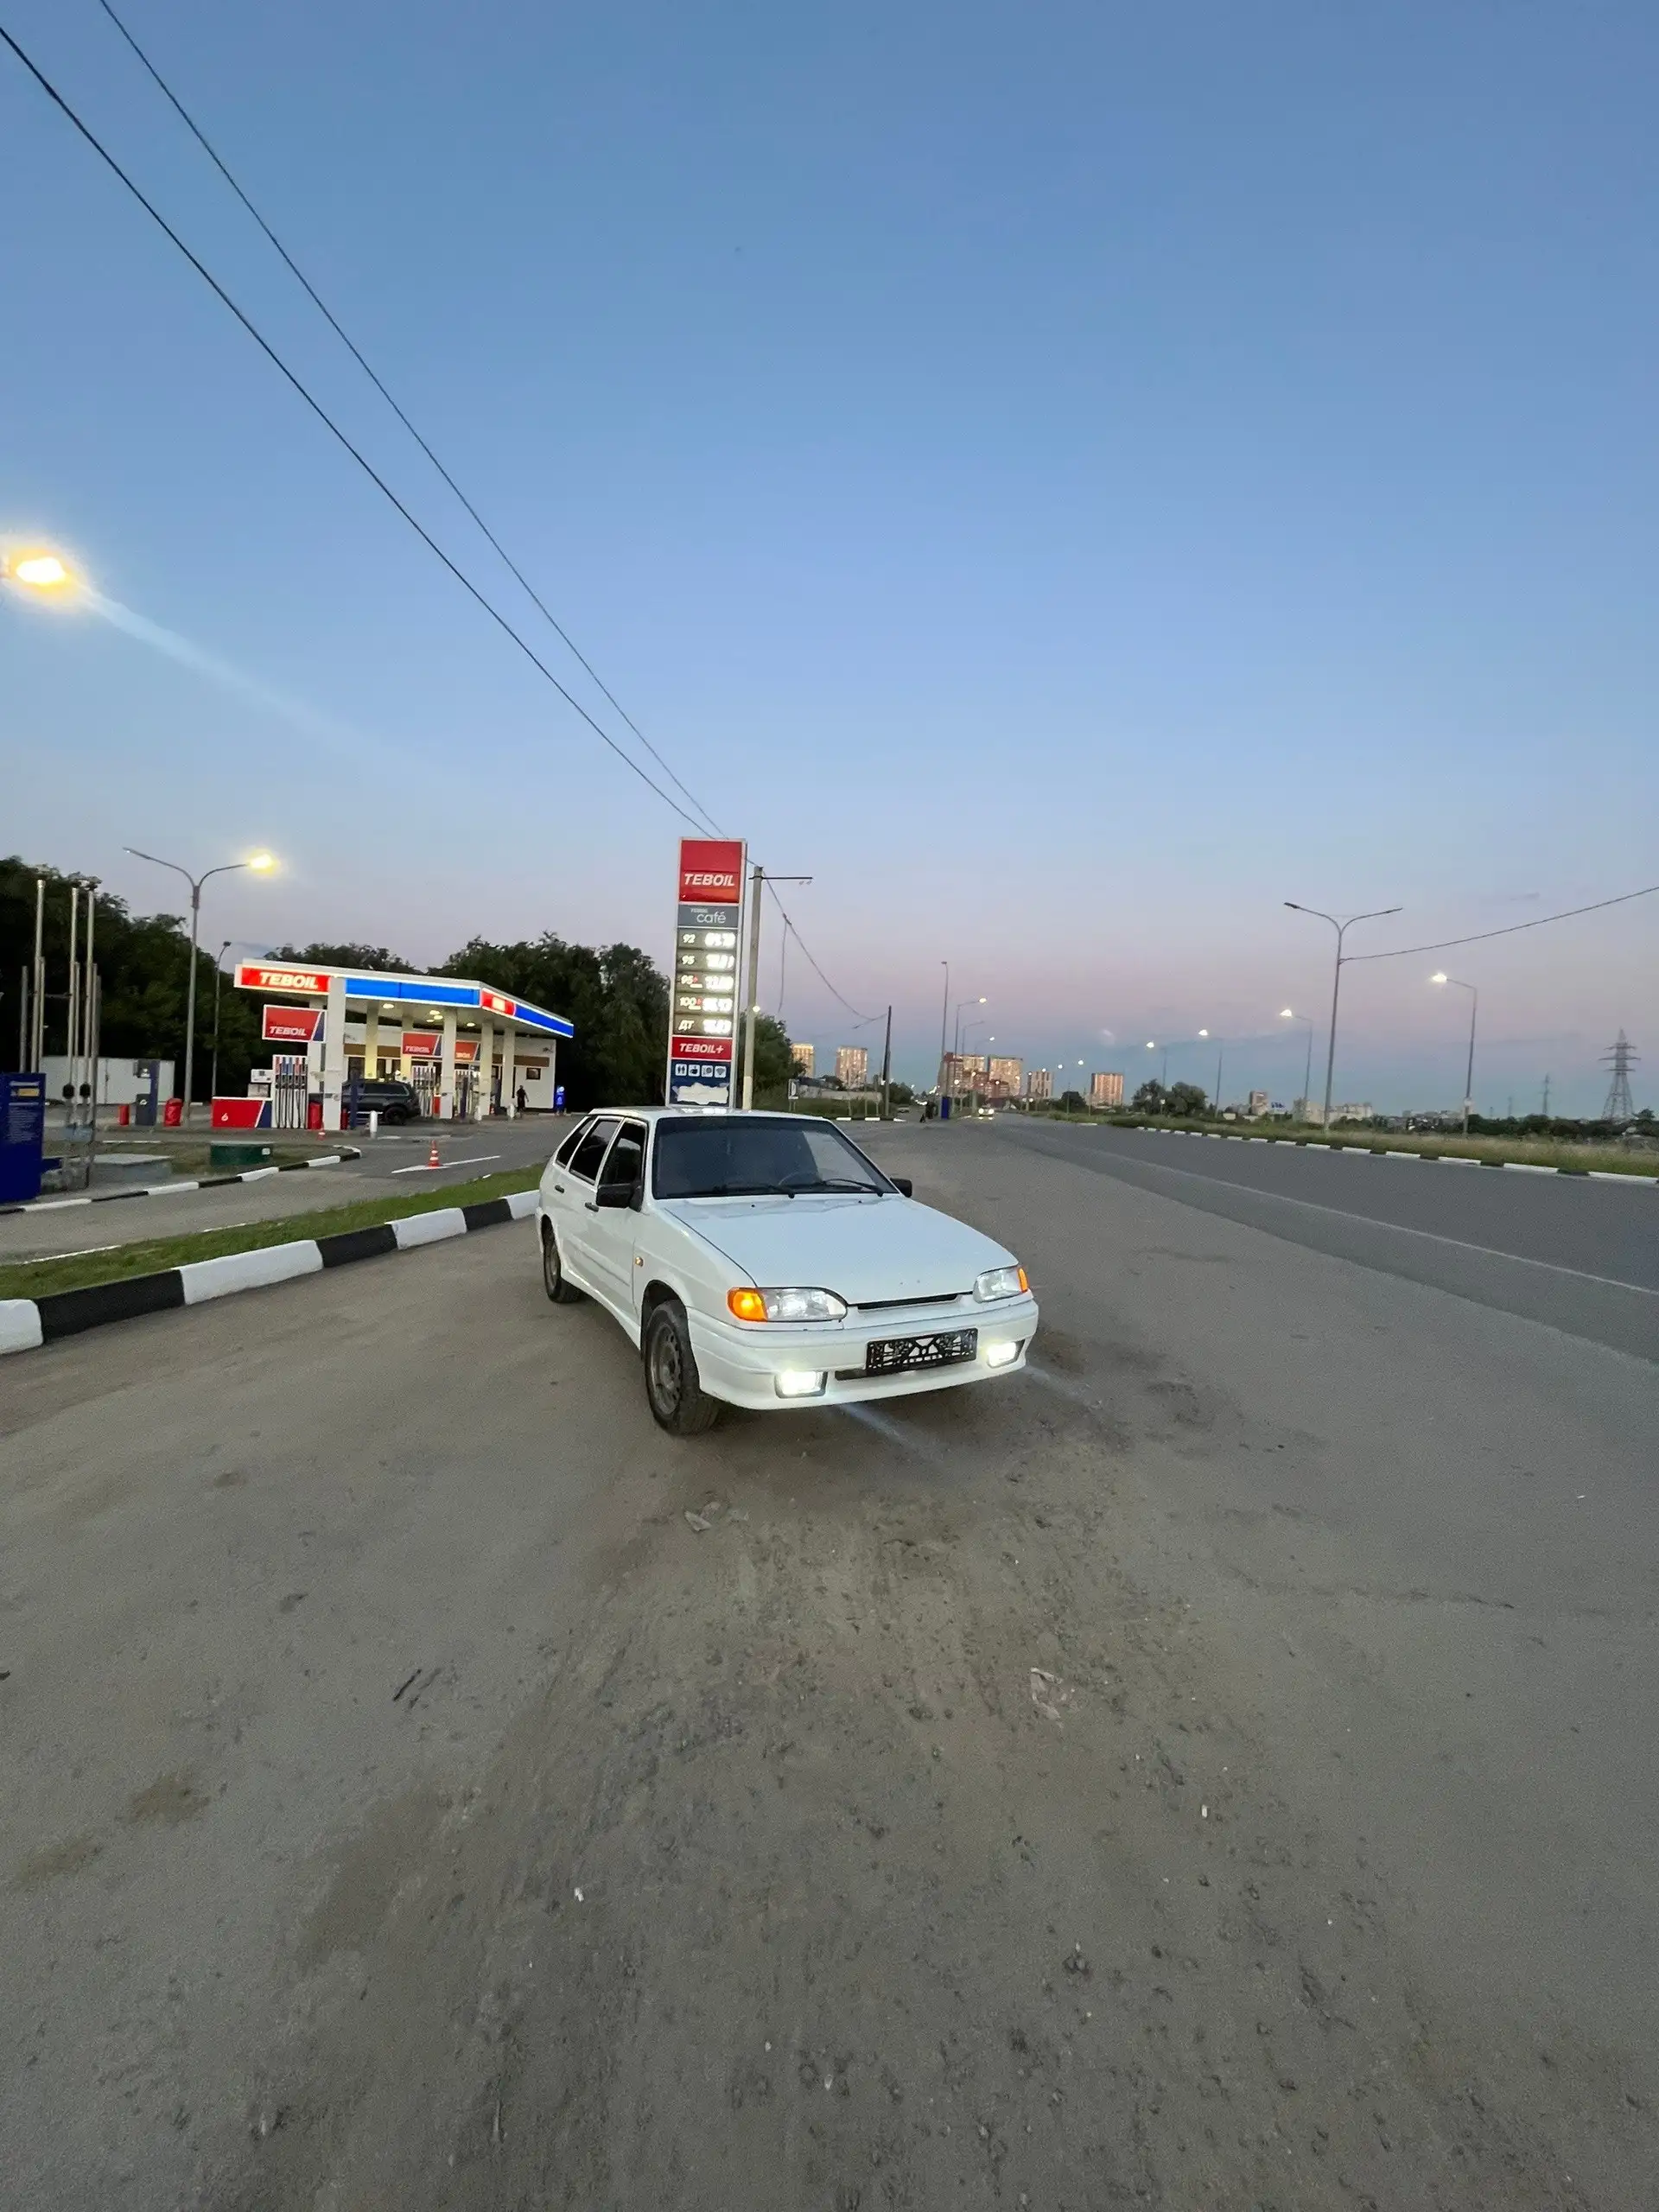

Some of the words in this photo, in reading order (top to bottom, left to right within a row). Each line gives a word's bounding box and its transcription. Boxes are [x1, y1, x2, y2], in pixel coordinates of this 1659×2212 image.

[684, 873, 734, 887] TEBOIL
[696, 911, 727, 924] café
[683, 933, 696, 944] 92
[682, 955, 696, 965] 95
[259, 972, 318, 989] TEBOIL
[269, 1026, 307, 1037] TEBOIL
[679, 1043, 724, 1054] TEBOIL+
[220, 1112, 229, 1122] 6
